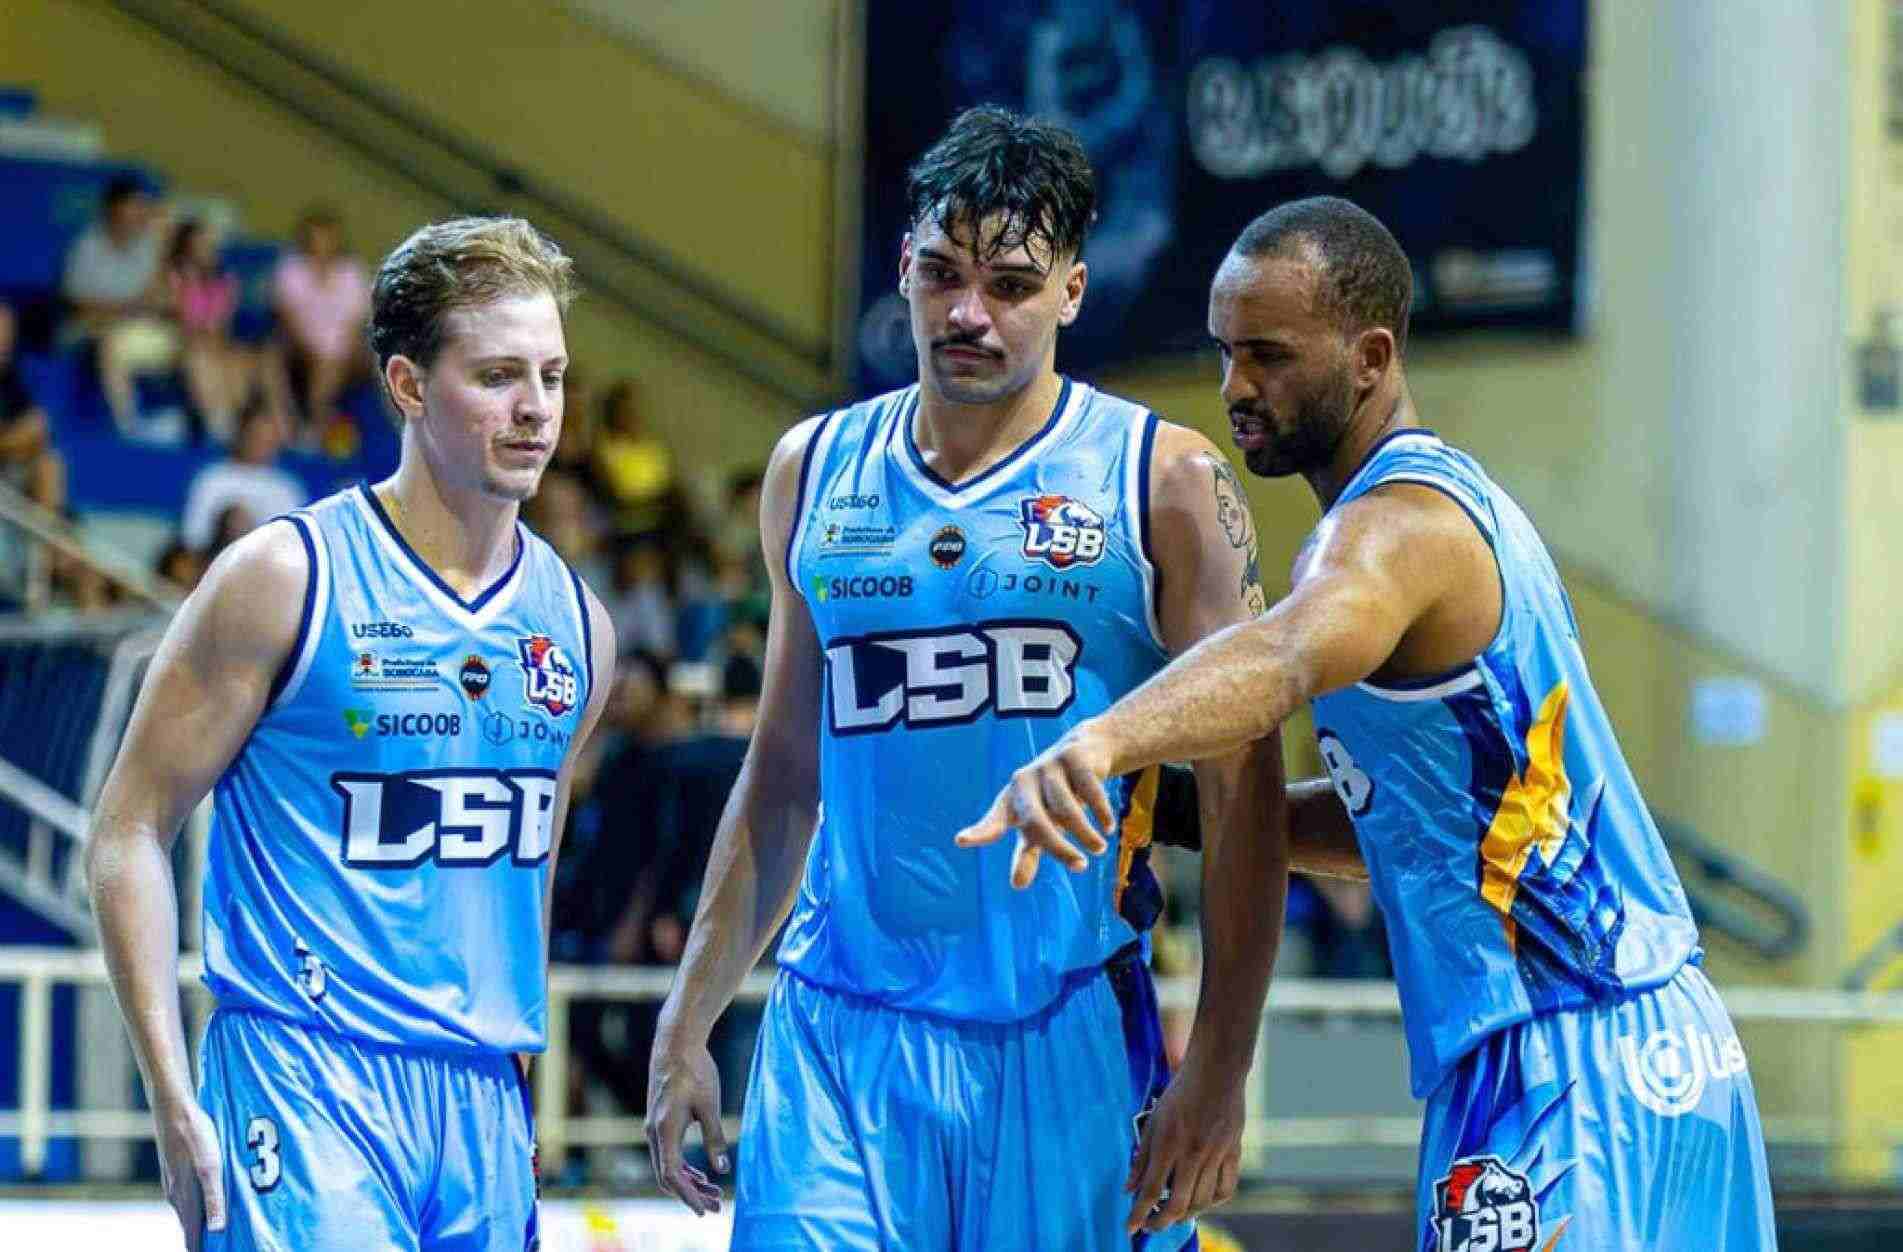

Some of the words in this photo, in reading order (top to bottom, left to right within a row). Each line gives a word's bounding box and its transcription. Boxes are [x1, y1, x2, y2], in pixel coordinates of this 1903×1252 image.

[830, 576, 912, 599] SICOOB
[1005, 573, 1101, 602] JOINT
[527, 666, 577, 705] LSB
[827, 619, 1082, 737] LSB
[377, 714, 460, 736] SICOOB
[247, 1116, 281, 1193] 3
[1438, 1203, 1538, 1252] LSB
